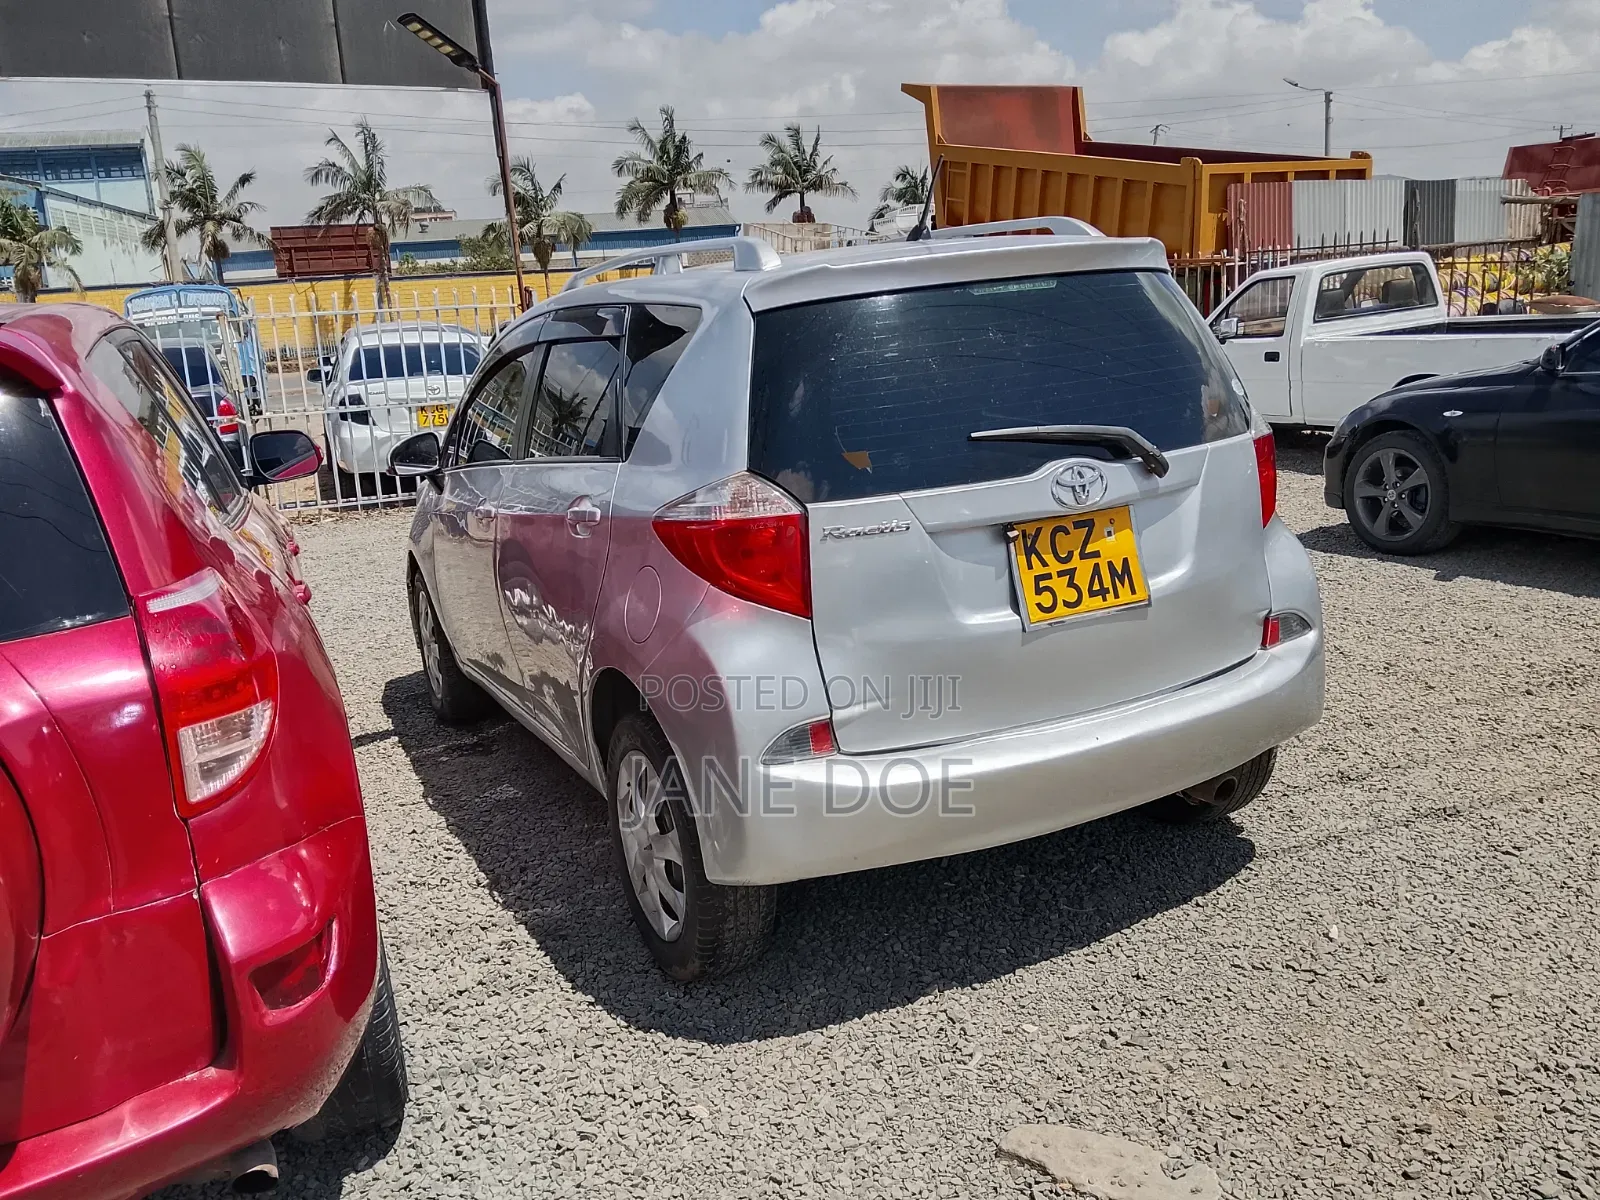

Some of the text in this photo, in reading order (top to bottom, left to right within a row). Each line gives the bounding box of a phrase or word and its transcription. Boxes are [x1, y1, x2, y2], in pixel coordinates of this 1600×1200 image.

[423, 414, 448, 425] 775
[1021, 518, 1101, 570] KCZ
[1034, 557, 1137, 614] 534M
